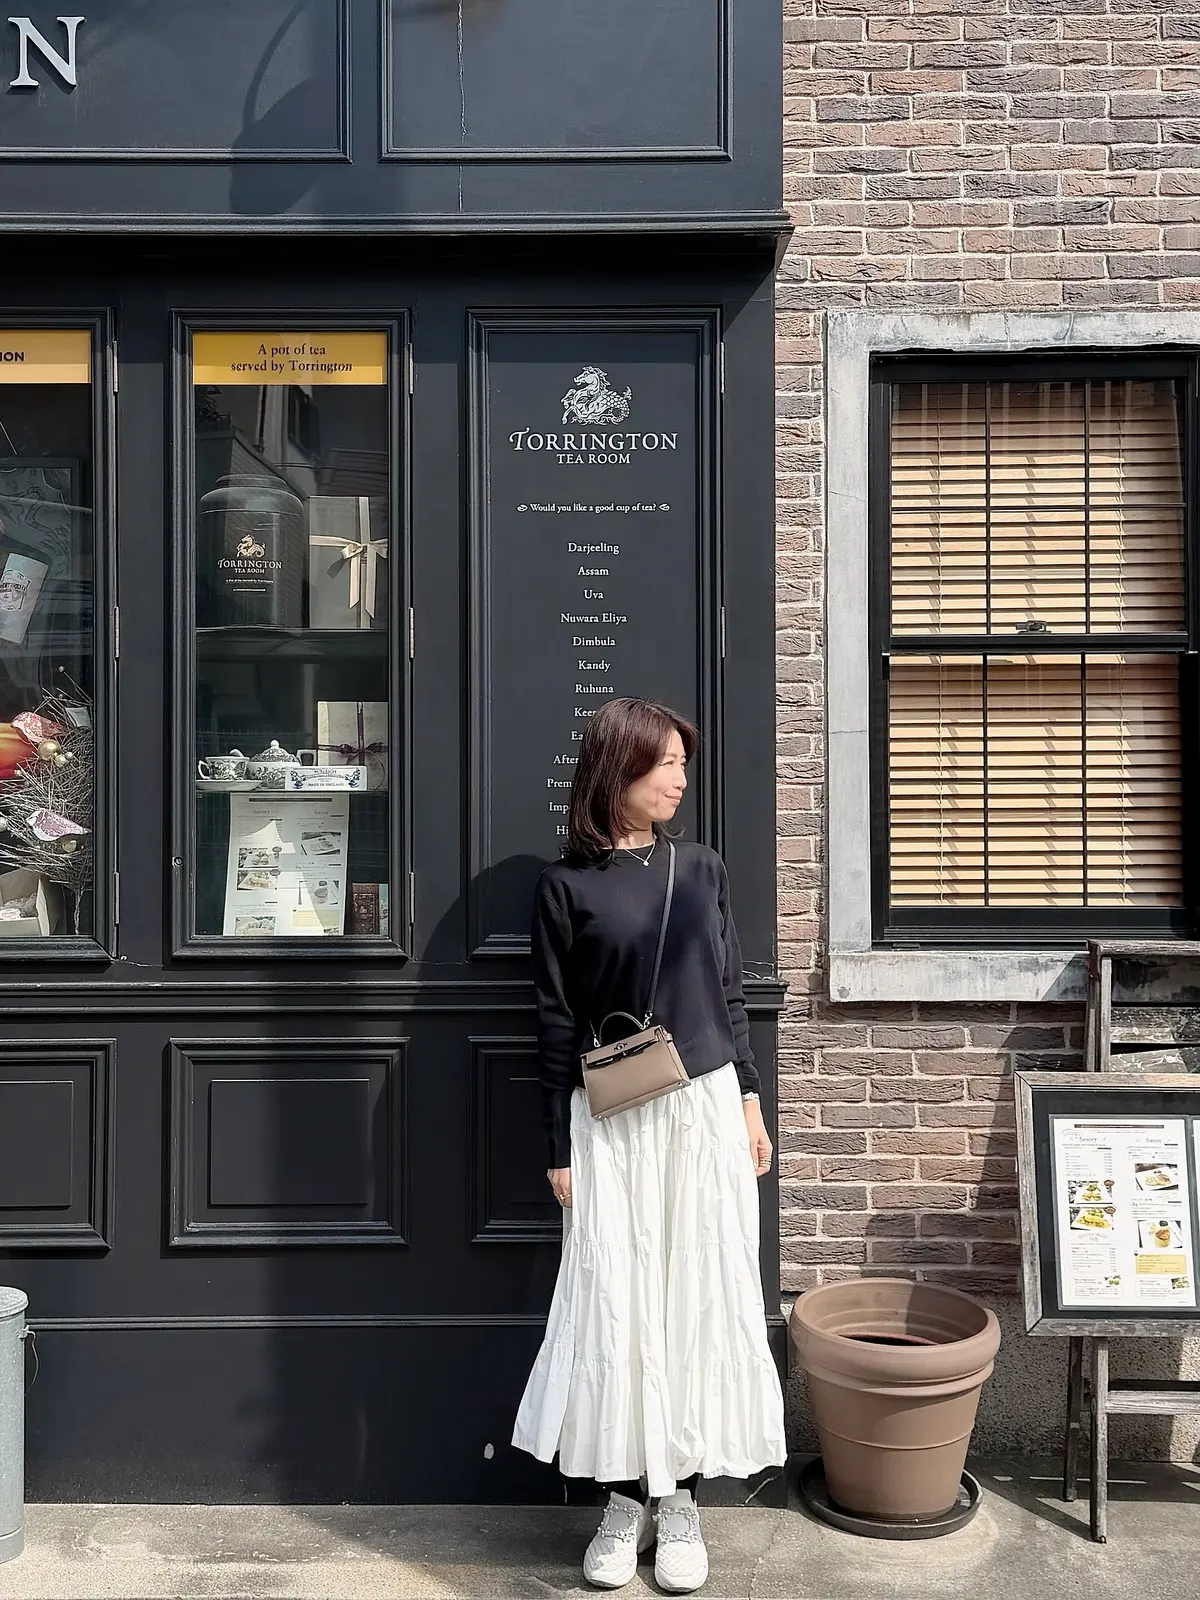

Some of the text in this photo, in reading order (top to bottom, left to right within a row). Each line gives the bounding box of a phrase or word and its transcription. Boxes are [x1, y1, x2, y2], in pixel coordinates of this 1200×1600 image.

[7, 16, 85, 86] N
[257, 343, 326, 357] A pot of tea
[231, 360, 353, 374] served by Torrington
[556, 453, 632, 464] TEA ROOM
[530, 503, 556, 512] Would
[557, 505, 571, 514] you
[573, 503, 587, 512] like
[595, 503, 614, 514] good
[631, 503, 641, 512] of
[642, 503, 657, 512] tea?
[568, 541, 620, 555] Darjeeling
[577, 566, 609, 576] Assam
[583, 589, 604, 599] Uva
[560, 612, 628, 625] Nuwara Eliya
[572, 636, 616, 646] Dimbula
[578, 660, 611, 672] Kandy
[575, 683, 614, 694] Ruhuna
